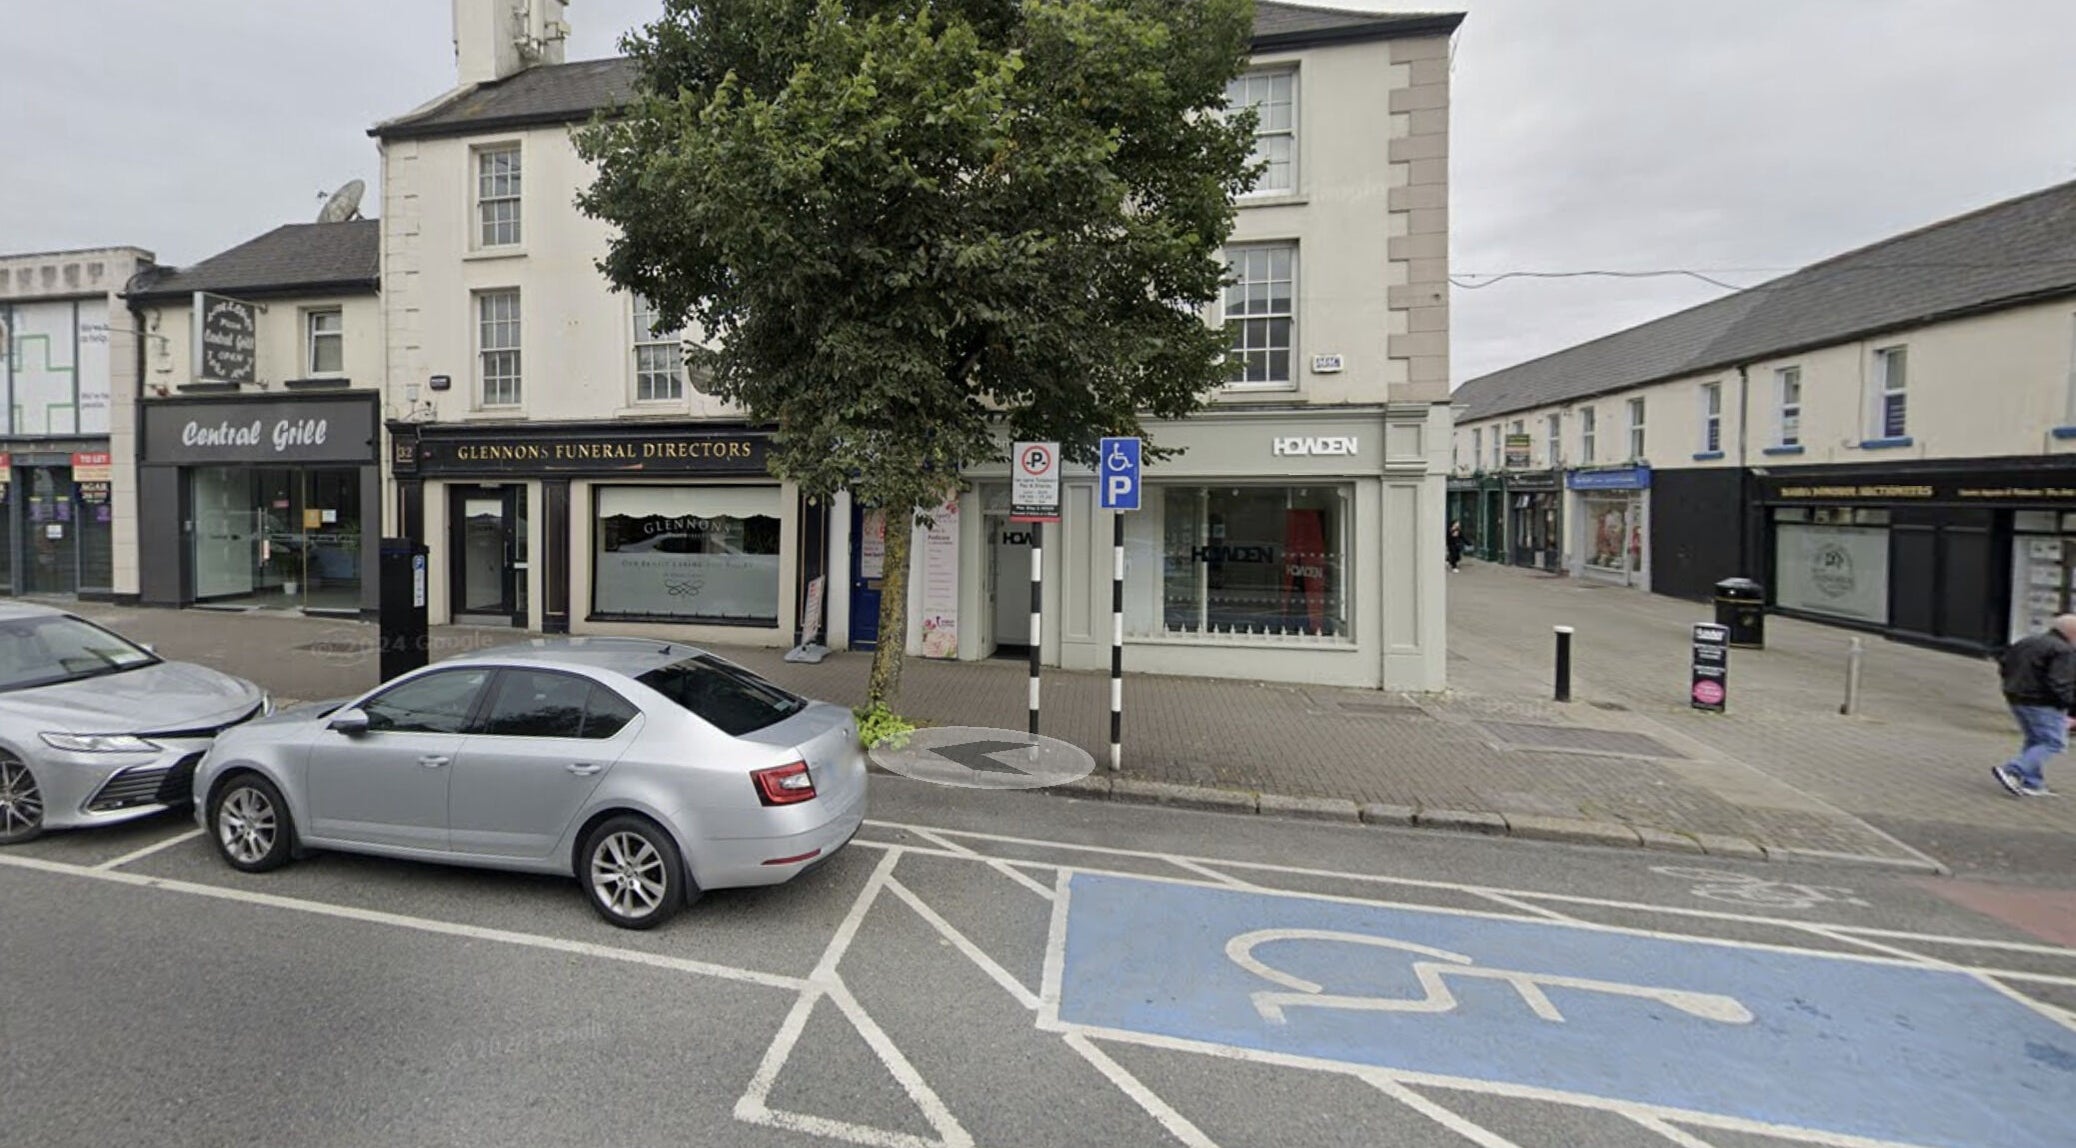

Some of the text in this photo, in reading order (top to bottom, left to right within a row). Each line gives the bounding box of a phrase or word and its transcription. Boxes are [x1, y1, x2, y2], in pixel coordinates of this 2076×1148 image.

[182, 419, 327, 451] Central Grill
[457, 442, 751, 460] GLENNONS FUNERAL DIRECTORS
[1273, 437, 1357, 456] HOWDEN
[1031, 452, 1043, 467] P
[1109, 476, 1132, 505] P
[643, 518, 730, 534] GLENNONS
[1003, 532, 1034, 545] HOW
[1191, 545, 1274, 563] HOWDEN
[1286, 563, 1323, 578] HOWDEN
